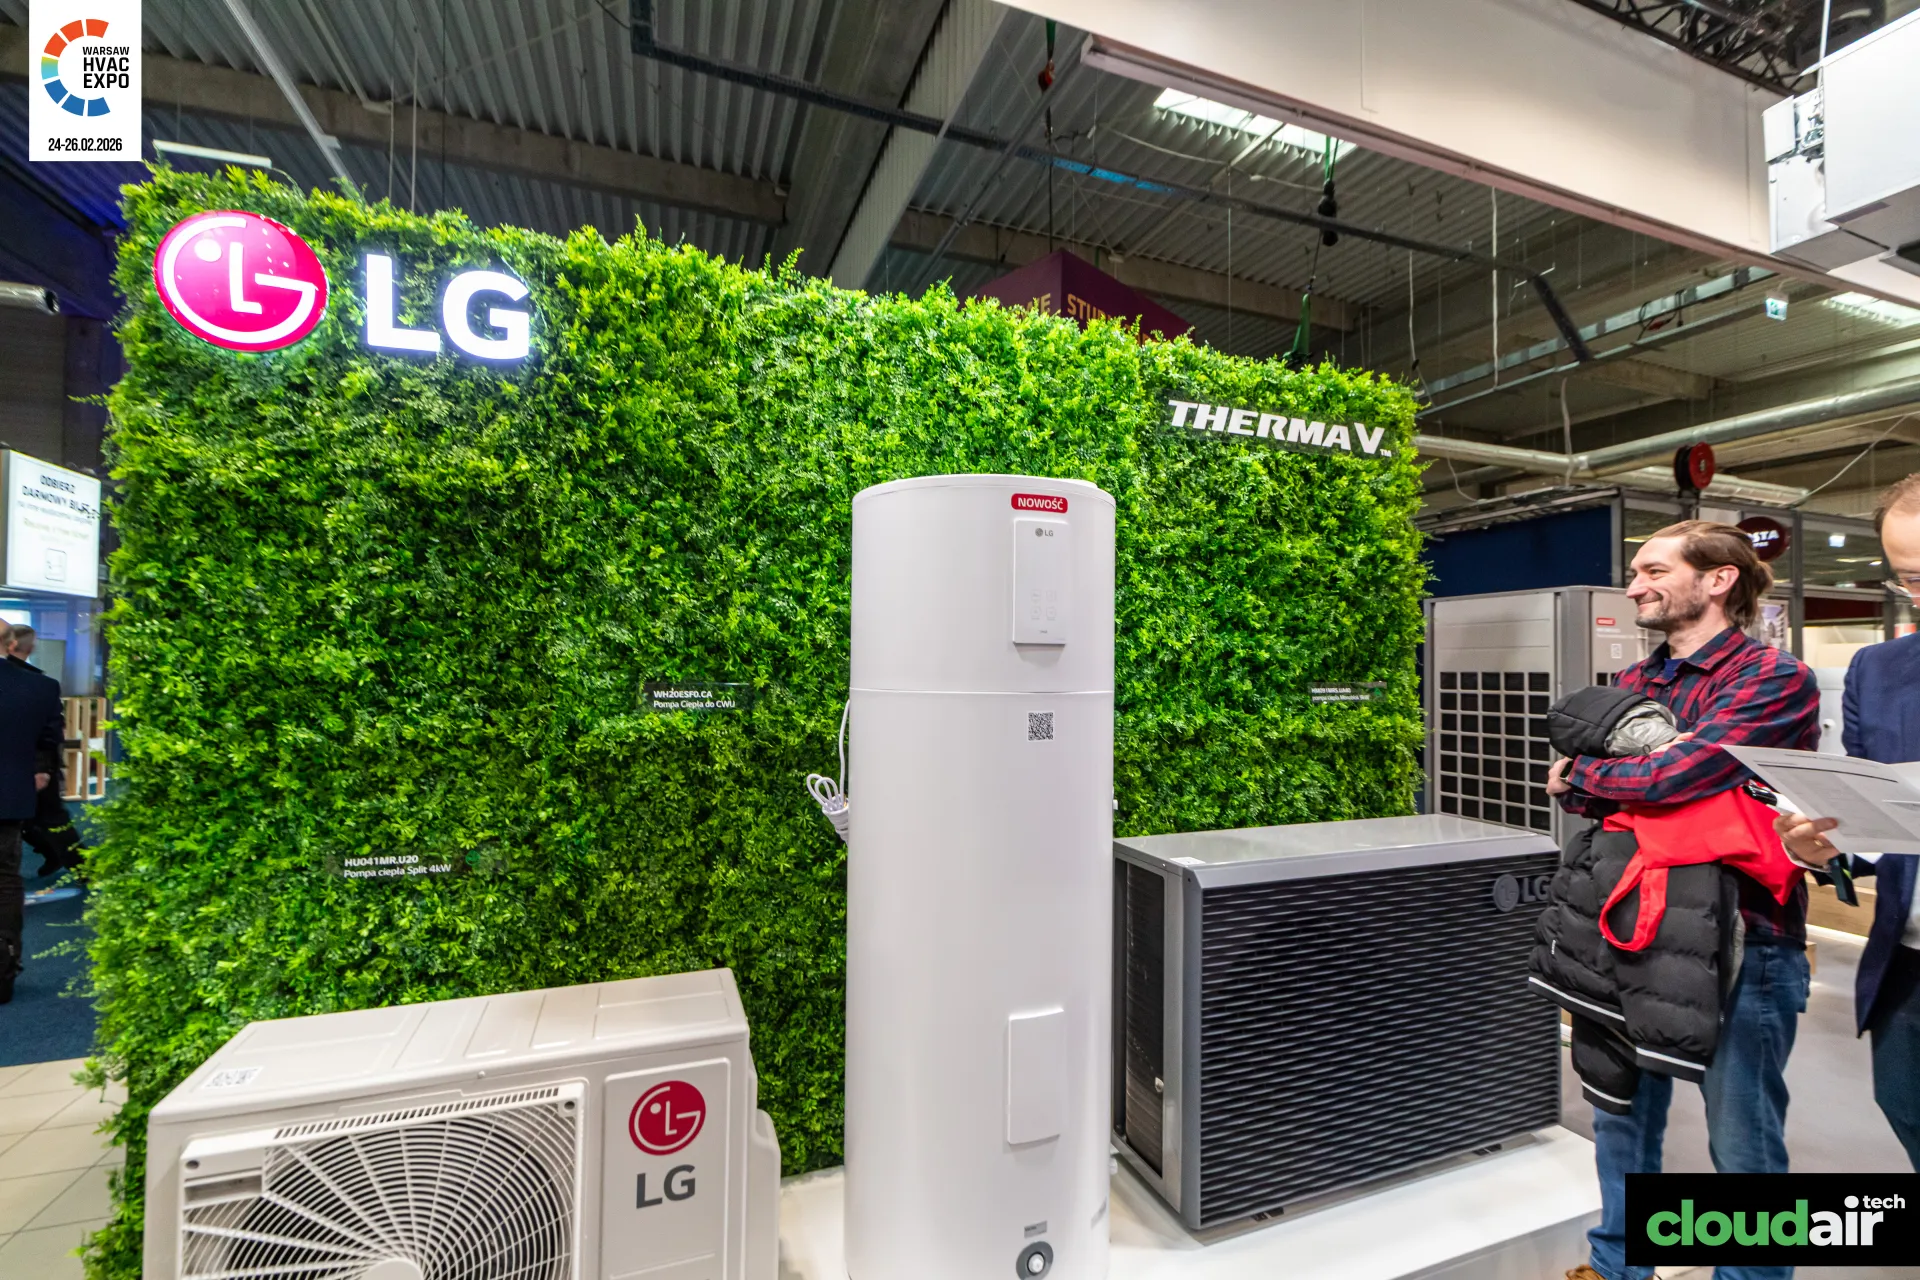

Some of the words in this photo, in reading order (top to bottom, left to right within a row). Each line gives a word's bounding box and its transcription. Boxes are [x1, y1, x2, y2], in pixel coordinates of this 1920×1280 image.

[366, 253, 530, 360] LG
[1067, 293, 1112, 321] STU
[1017, 497, 1064, 511] NOWOŚĆ
[653, 700, 680, 709] Pompa
[344, 855, 419, 867] HU041MR.U20
[344, 869, 377, 879] Pompa
[407, 865, 428, 876] Split
[429, 863, 452, 873] 4kW
[1523, 875, 1551, 903] LG
[636, 1164, 696, 1209] LG
